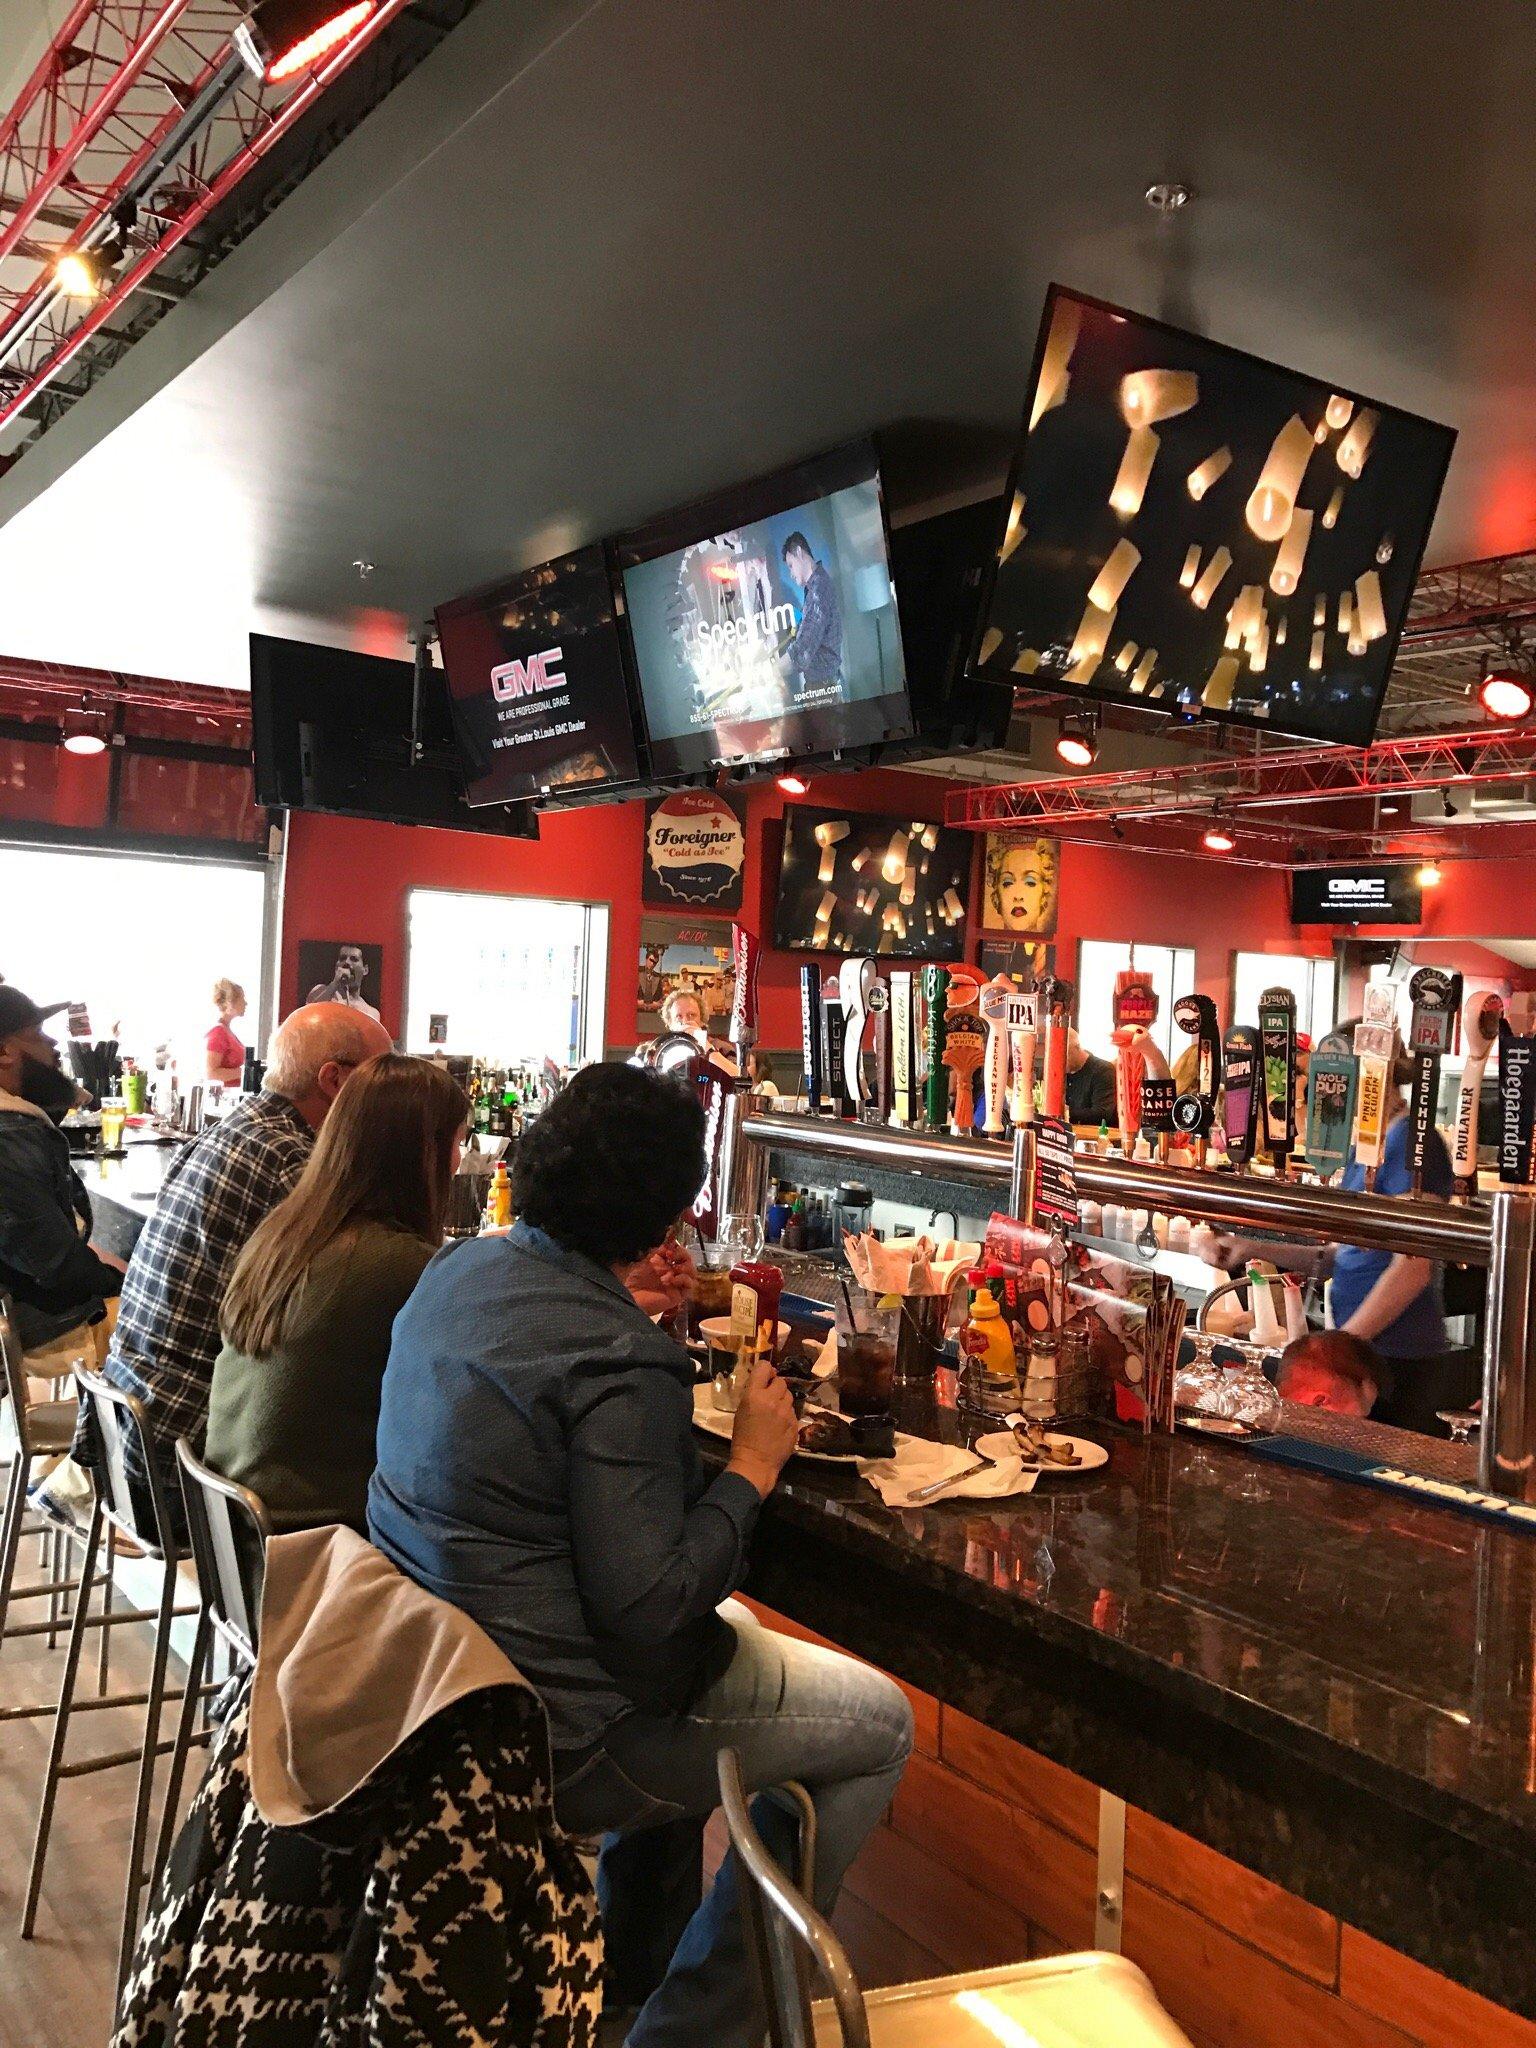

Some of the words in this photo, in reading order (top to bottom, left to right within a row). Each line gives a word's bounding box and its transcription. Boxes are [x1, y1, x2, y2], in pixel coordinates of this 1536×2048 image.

[490, 646, 568, 703] GMC
[793, 683, 843, 702] spectrum.com
[496, 712, 506, 722] WE
[506, 709, 516, 720] ARE
[515, 700, 553, 717] PROFESSIONAL
[552, 694, 571, 709] GRADE
[491, 738, 504, 750] Visit
[503, 736, 515, 747] Your
[514, 732, 534, 745] Greater
[554, 722, 568, 735] GMC
[567, 719, 586, 733] Dealer
[655, 827, 737, 849] Foreigner
[693, 848, 706, 857] as
[1328, 879, 1386, 893] GMC
[737, 931, 748, 1028] Budweiser
[1009, 1004, 1034, 1025] IPA
[1120, 1010, 1153, 1020] HAZE
[1268, 1018, 1283, 1027] IPA
[950, 1033, 981, 1041] BELGIAN
[1417, 1028, 1441, 1046] IPA
[832, 1017, 842, 1083] SELECT
[992, 1035, 1000, 1079] BELGIAN
[1315, 1081, 1347, 1095] PUP
[1316, 1072, 1348, 1083] WOLF
[990, 1082, 998, 1113] WHITE
[1140, 1086, 1173, 1098] OOSE
[1370, 1077, 1380, 1118] SCULPIN
[1413, 1056, 1433, 1168] DESCHUTES
[1502, 1047, 1531, 1170] Hoegaarden
[1455, 1087, 1475, 1161] PAULANER
